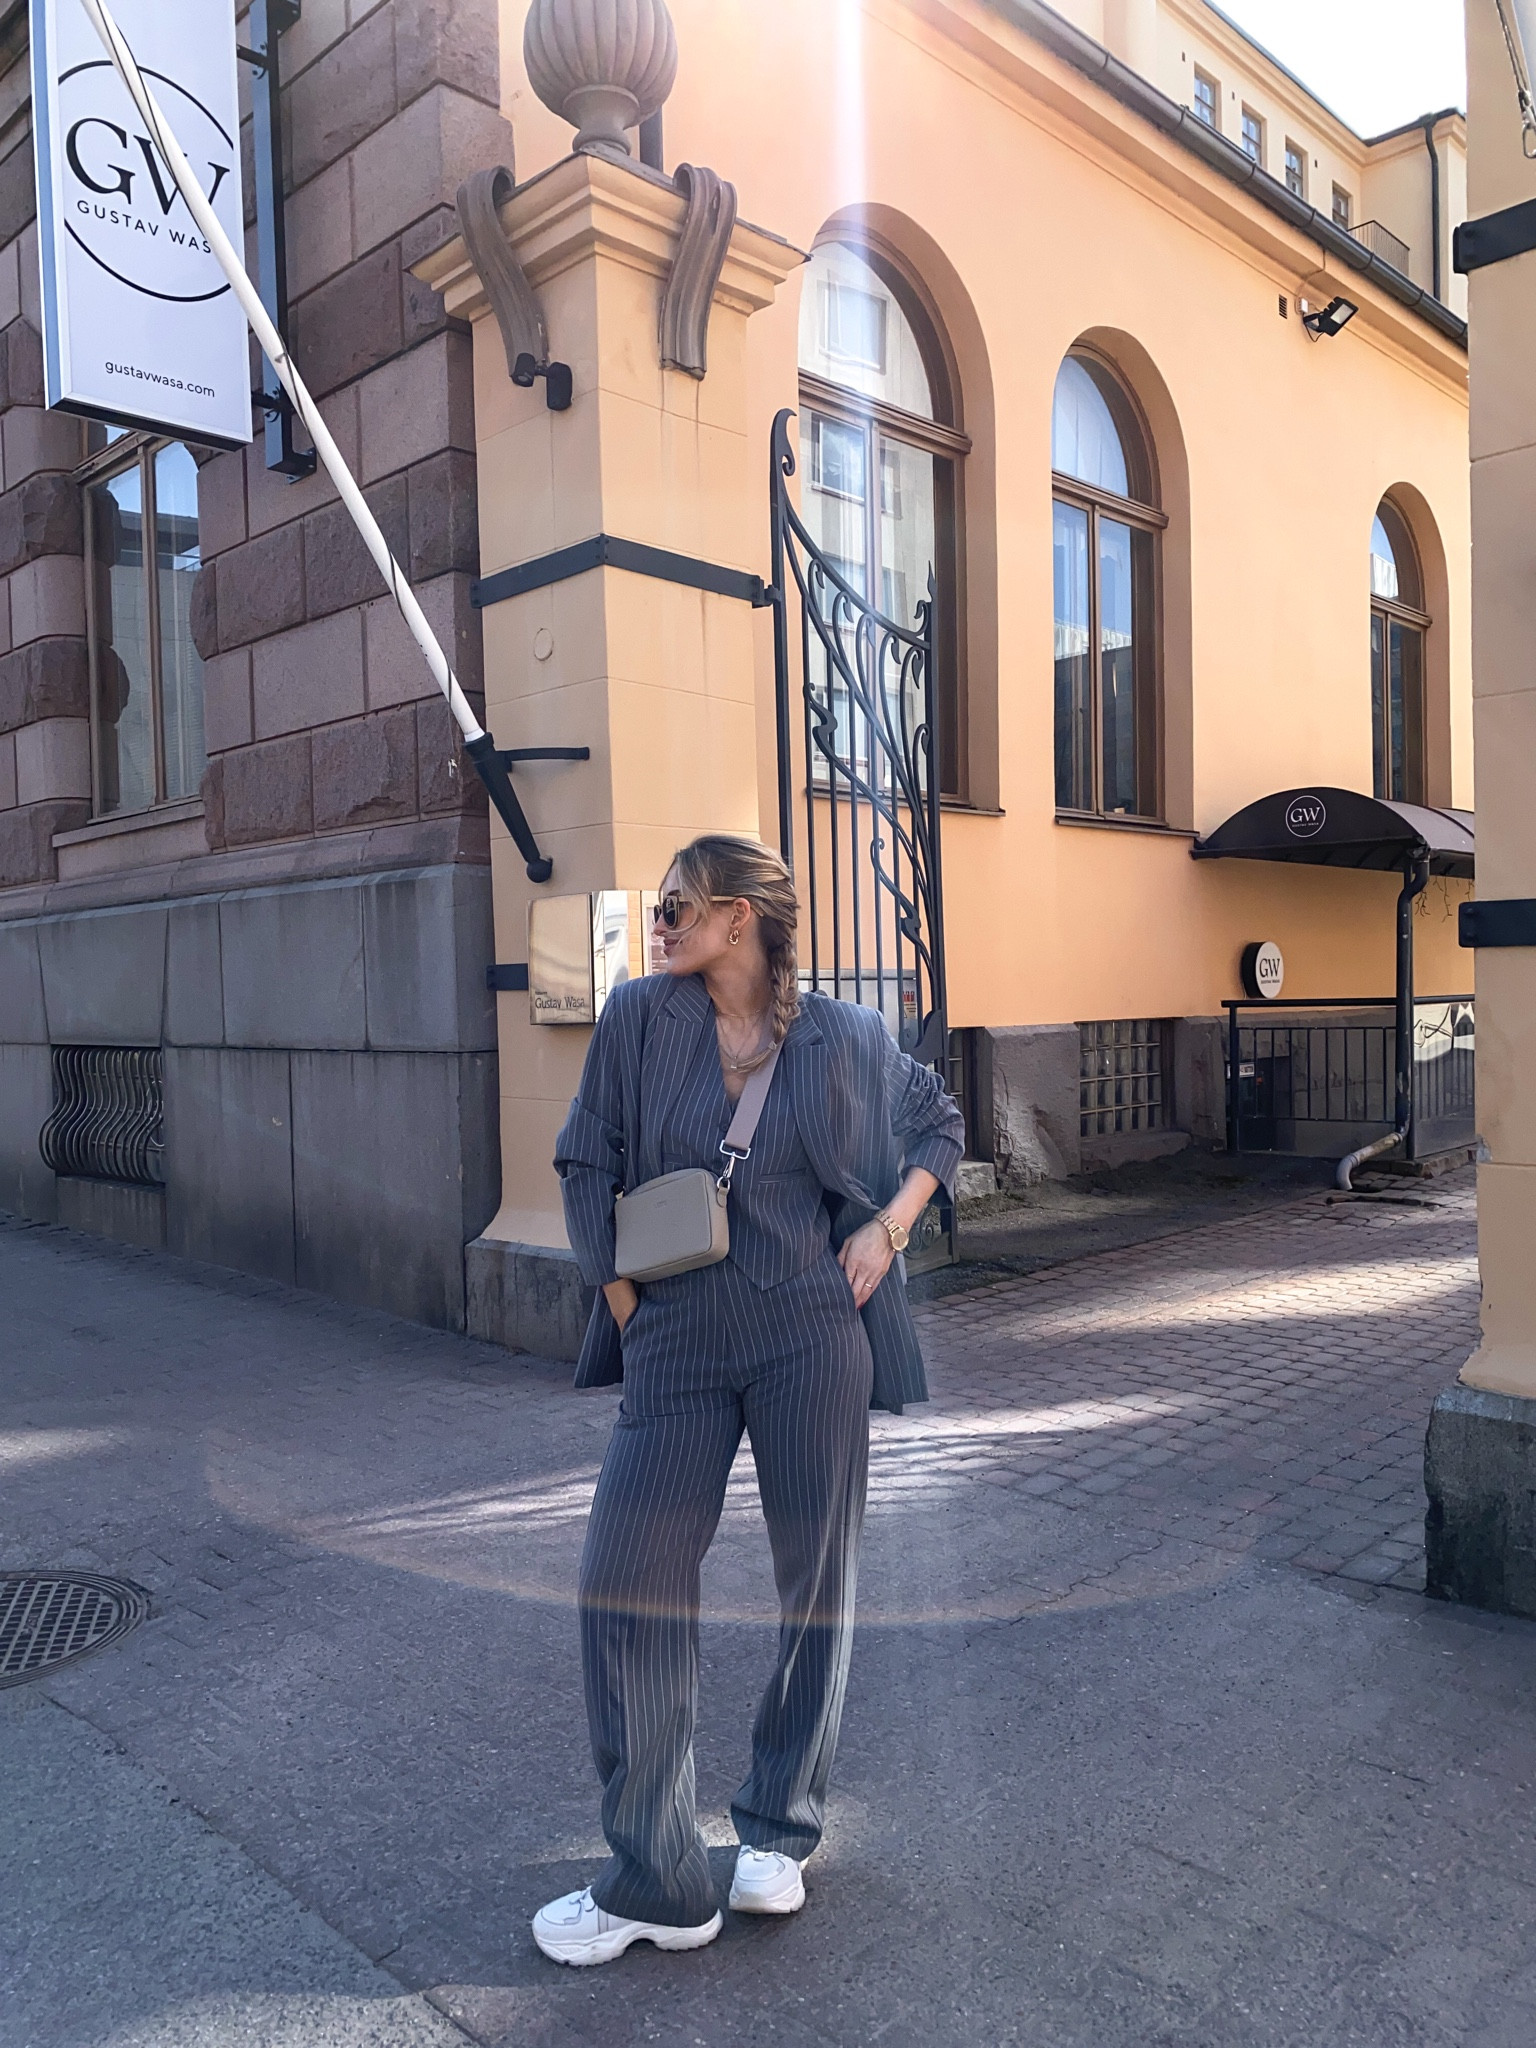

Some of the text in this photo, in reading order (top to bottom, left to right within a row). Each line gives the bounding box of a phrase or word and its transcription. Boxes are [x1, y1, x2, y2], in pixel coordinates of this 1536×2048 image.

[76, 199, 213, 254] GUSTAV WAS
[104, 361, 216, 398] gustavwasa.com
[1290, 806, 1321, 823] GW
[1259, 957, 1281, 978] GW
[534, 995, 585, 1009] Gustav Wasa
